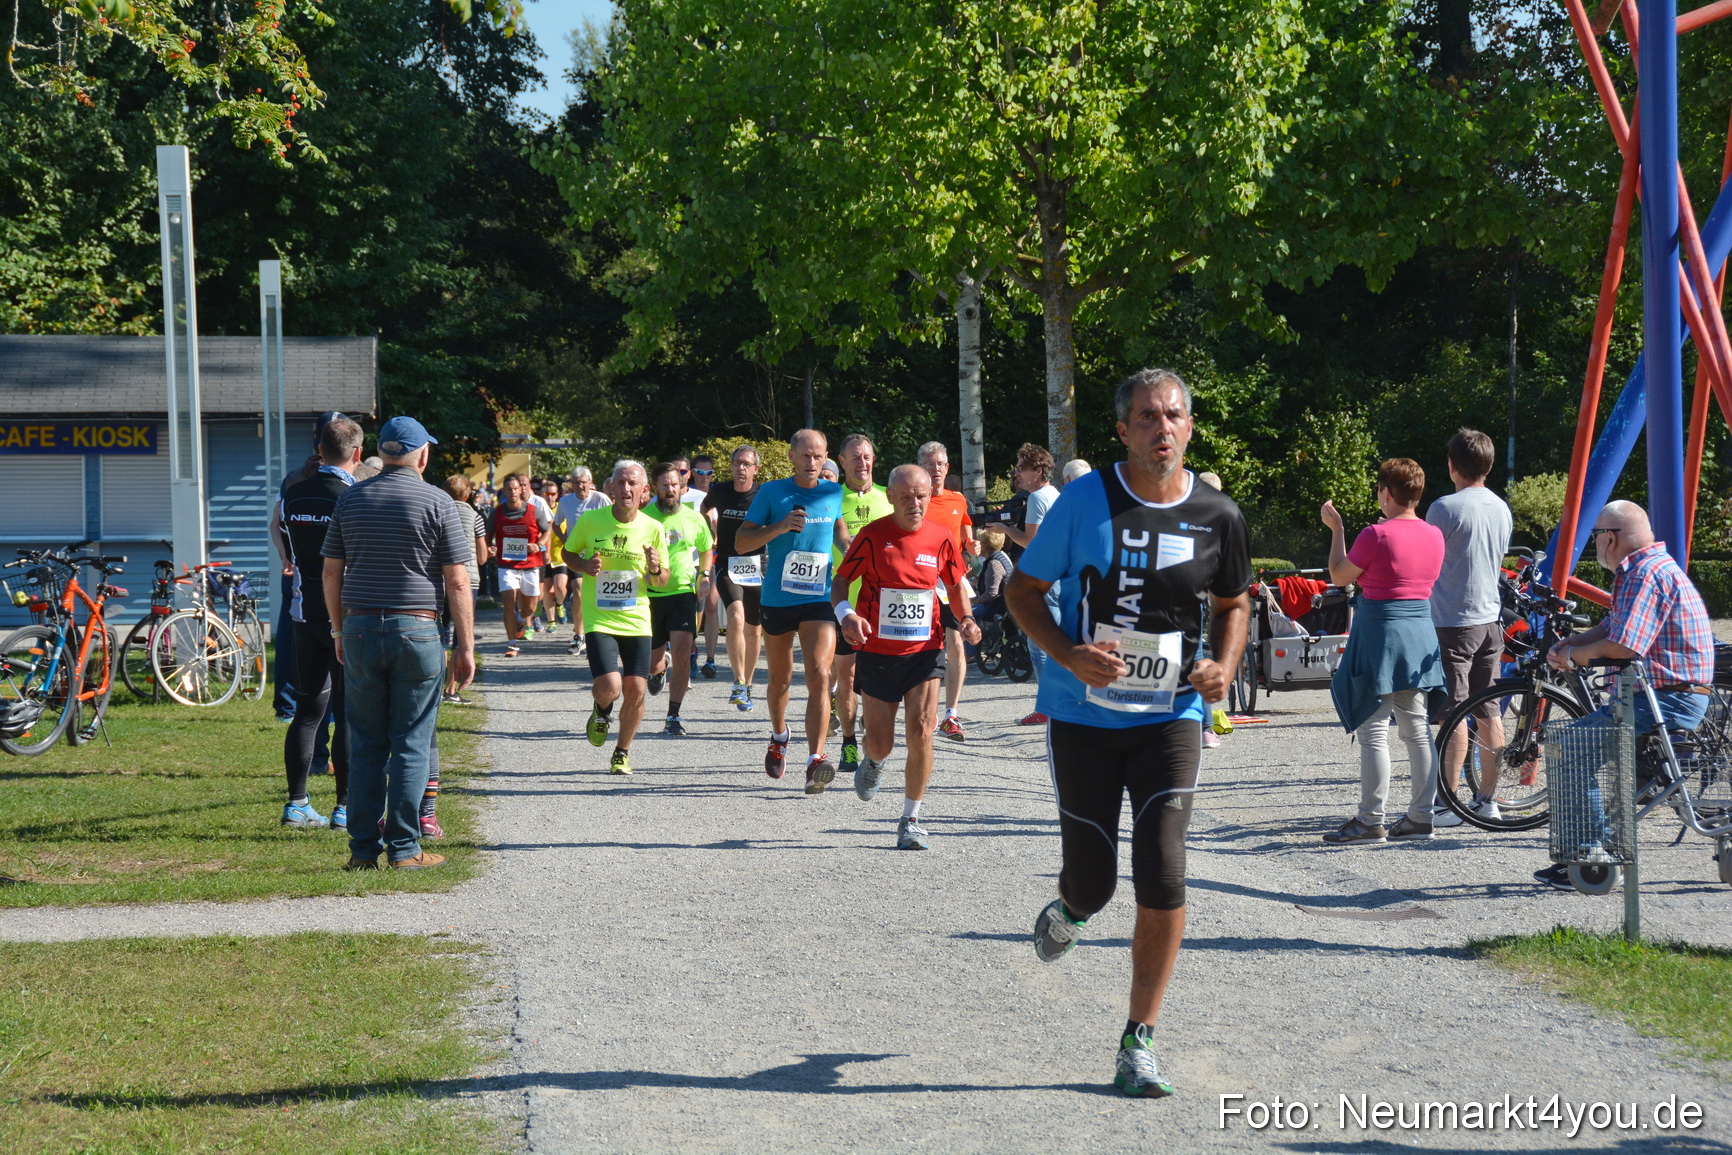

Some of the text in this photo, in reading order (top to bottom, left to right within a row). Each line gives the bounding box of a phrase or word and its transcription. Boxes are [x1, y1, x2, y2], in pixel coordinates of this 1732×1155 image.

[805, 516, 832, 524] hasit.de
[506, 543, 525, 552] 3060
[915, 553, 937, 564] JURA
[733, 564, 756, 575] 2325
[789, 561, 821, 577] 2611
[602, 581, 633, 595] 2294
[887, 603, 926, 620] 2335
[893, 627, 918, 635] Herbert
[1106, 689, 1154, 703] Christian
